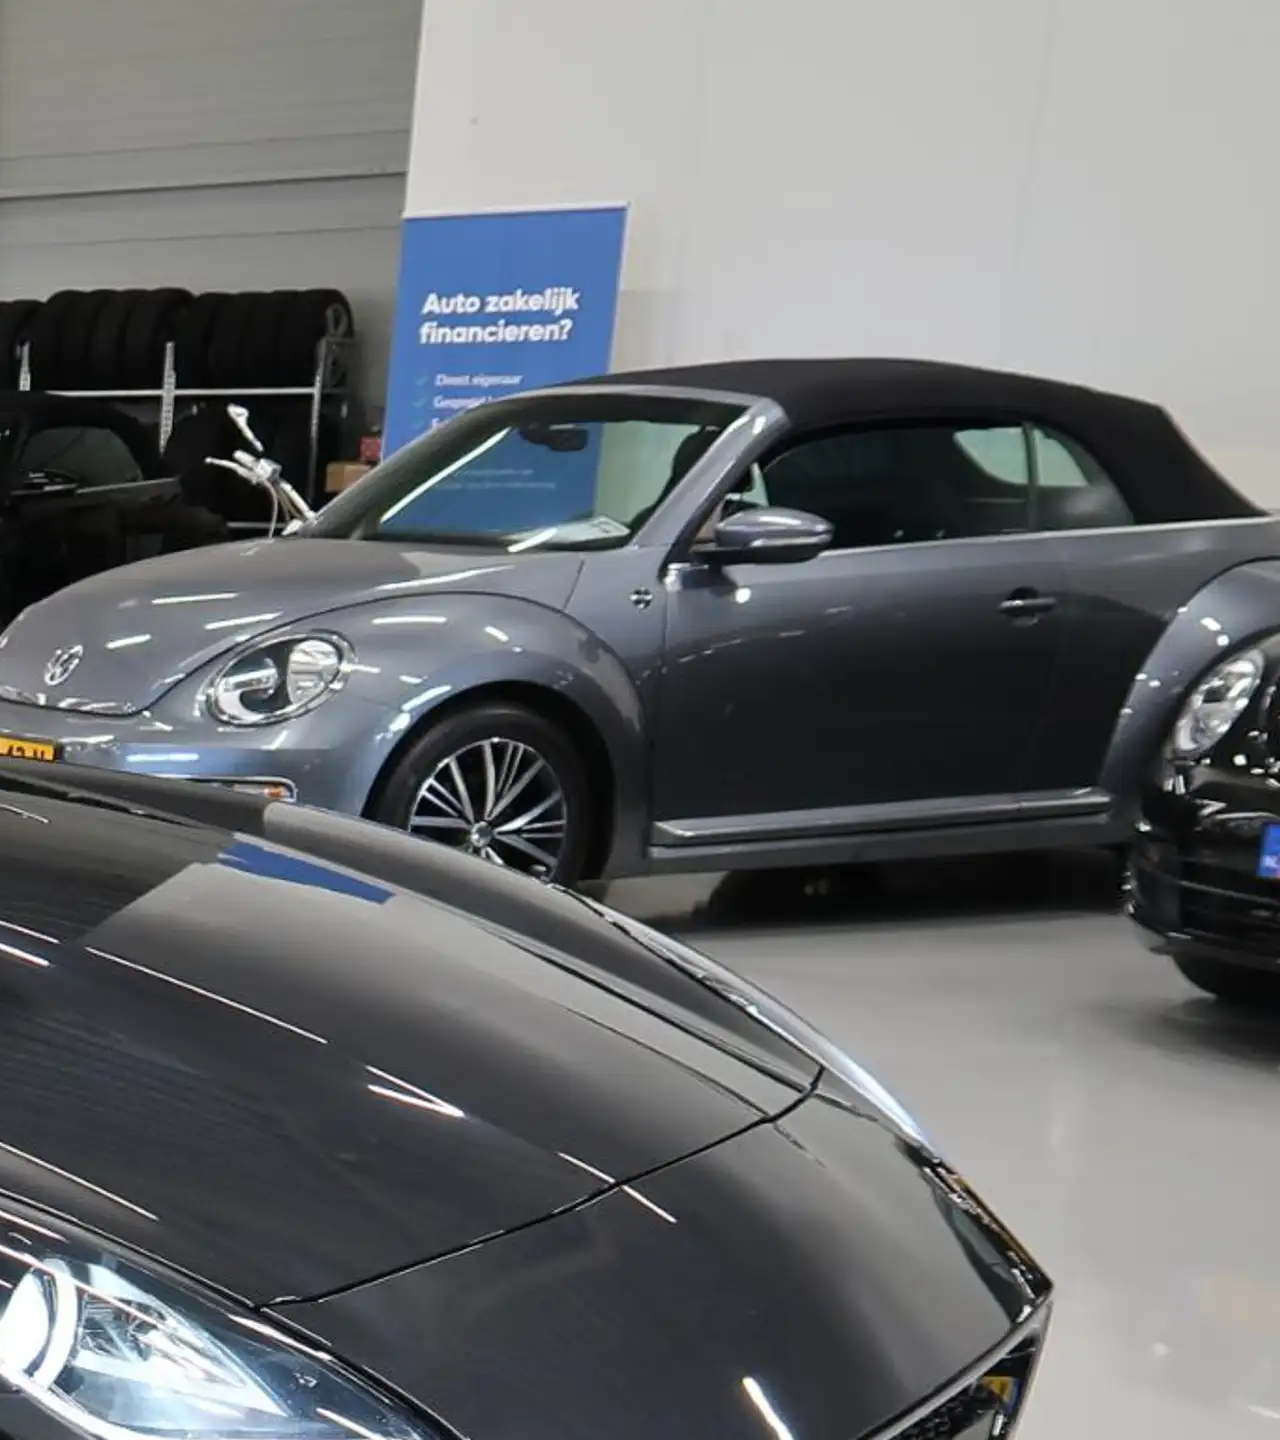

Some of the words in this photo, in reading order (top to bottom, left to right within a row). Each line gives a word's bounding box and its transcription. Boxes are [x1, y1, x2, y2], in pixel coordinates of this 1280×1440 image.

[421, 292, 480, 315] Auto
[484, 286, 581, 317] zakelijk
[419, 318, 574, 345] financieren?
